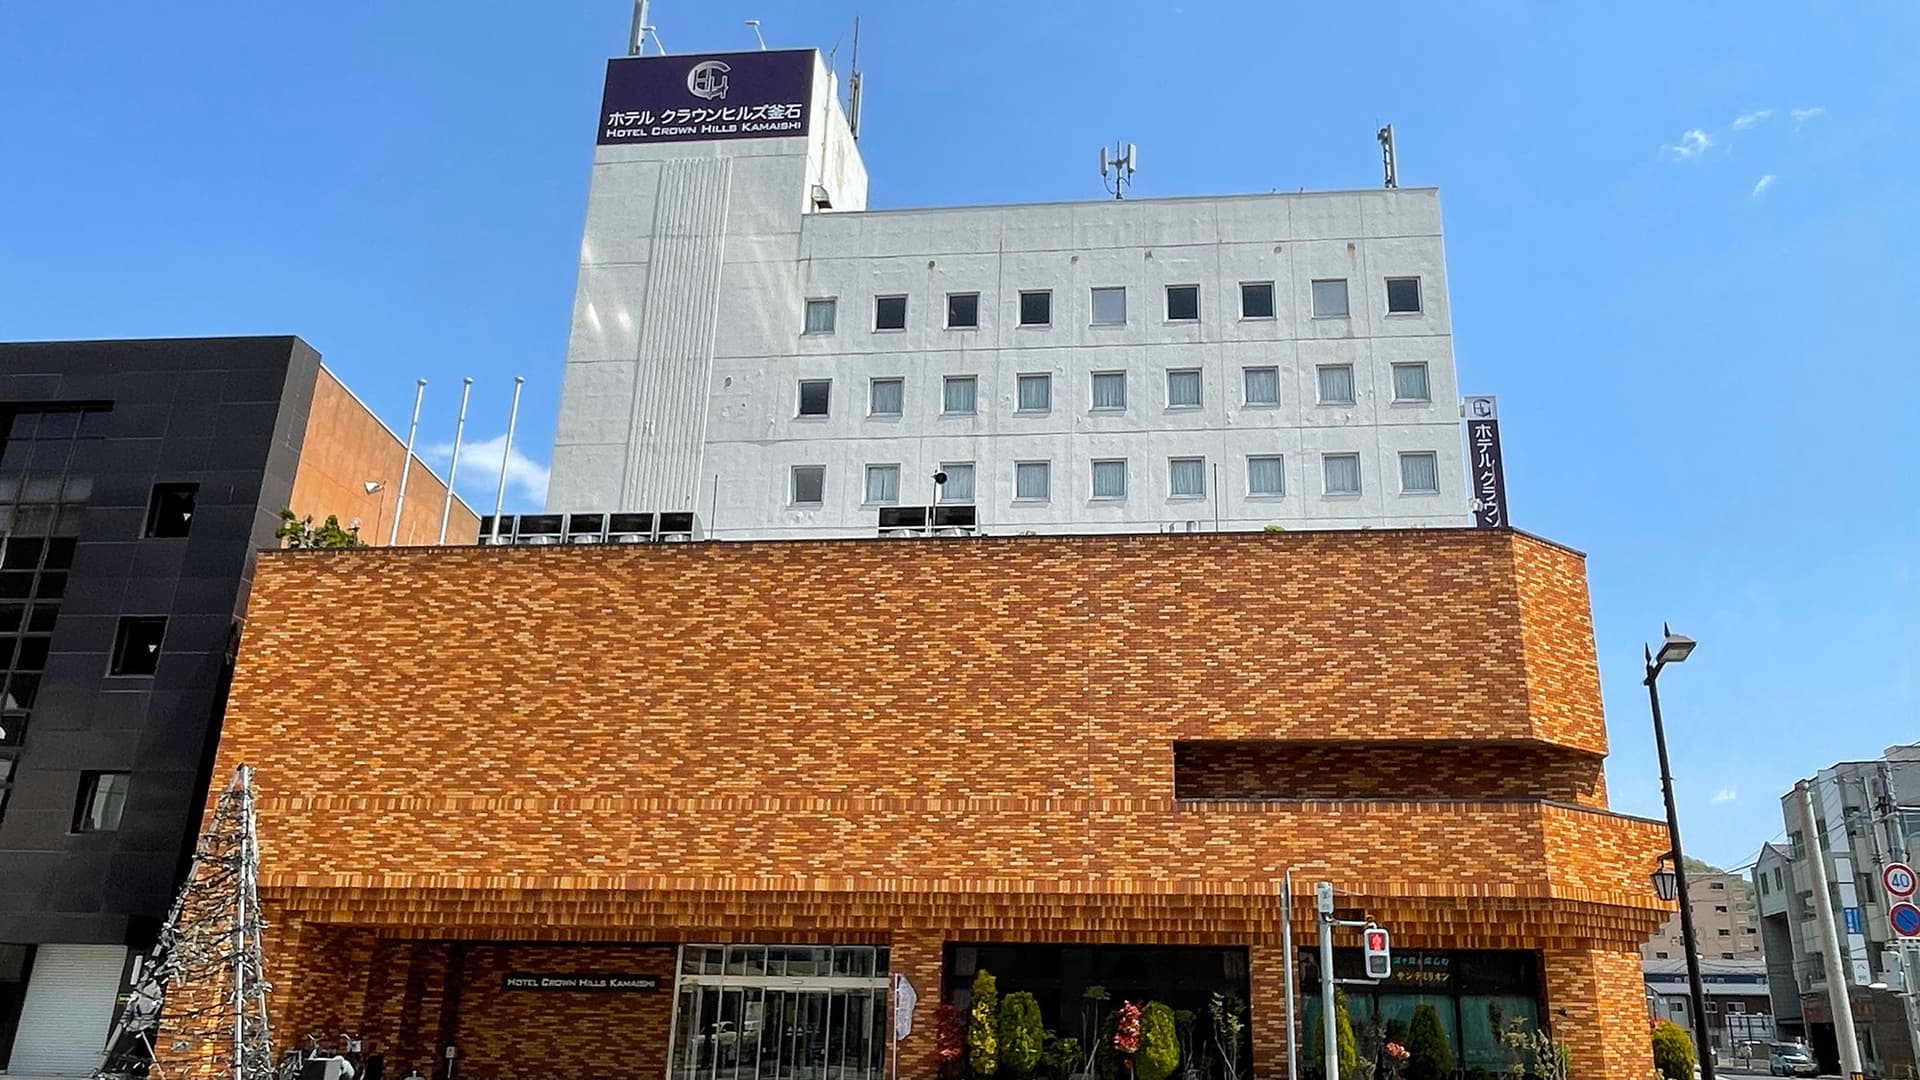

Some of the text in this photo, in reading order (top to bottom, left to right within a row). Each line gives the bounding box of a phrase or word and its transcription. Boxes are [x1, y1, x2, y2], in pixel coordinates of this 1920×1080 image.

[607, 103, 802, 127] ホテル クラウンヒルズ釜石
[606, 121, 801, 138] HOTEL CROWN HILLS KAMAISHI
[1892, 873, 1909, 888] 40
[507, 977, 655, 988] HOTEL CROWN HILLS KAMAISHI
